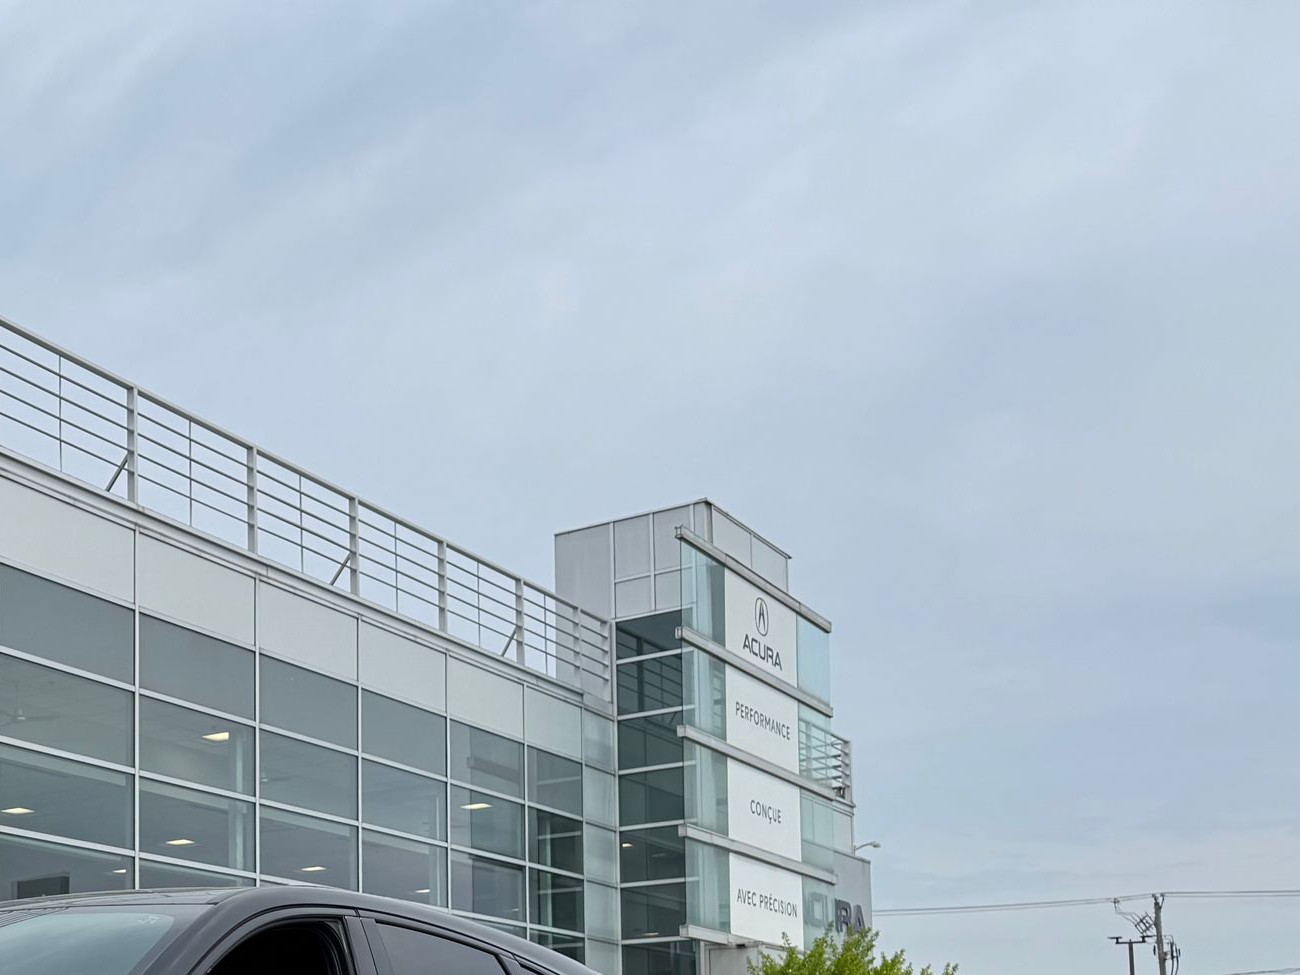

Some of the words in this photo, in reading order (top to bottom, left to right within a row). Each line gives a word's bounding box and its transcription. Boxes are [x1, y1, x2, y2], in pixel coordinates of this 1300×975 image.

[743, 633, 783, 671] ACURA
[735, 701, 791, 740] PERFORMANCE
[750, 799, 782, 825] CONÇUE
[736, 888, 757, 907] AVEC
[759, 893, 798, 919] PRÉCISION
